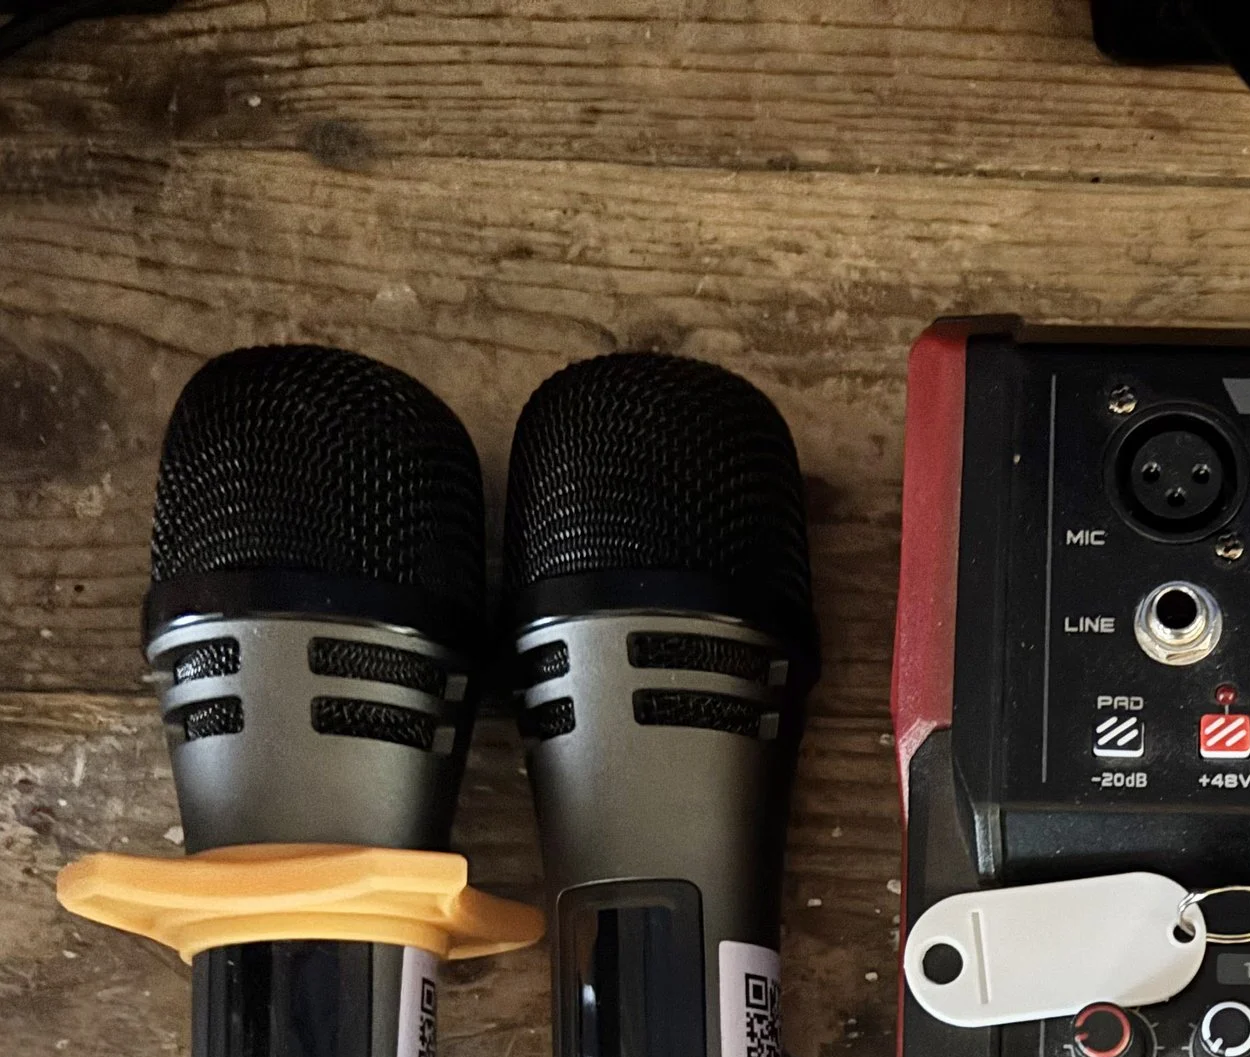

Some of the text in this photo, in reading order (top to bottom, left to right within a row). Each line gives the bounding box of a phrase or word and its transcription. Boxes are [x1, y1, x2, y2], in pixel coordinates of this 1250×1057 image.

[1066, 530, 1106, 546] MIC
[1065, 617, 1115, 633] LINE
[1097, 696, 1144, 711] PAD
[1091, 772, 1148, 788] -20dB
